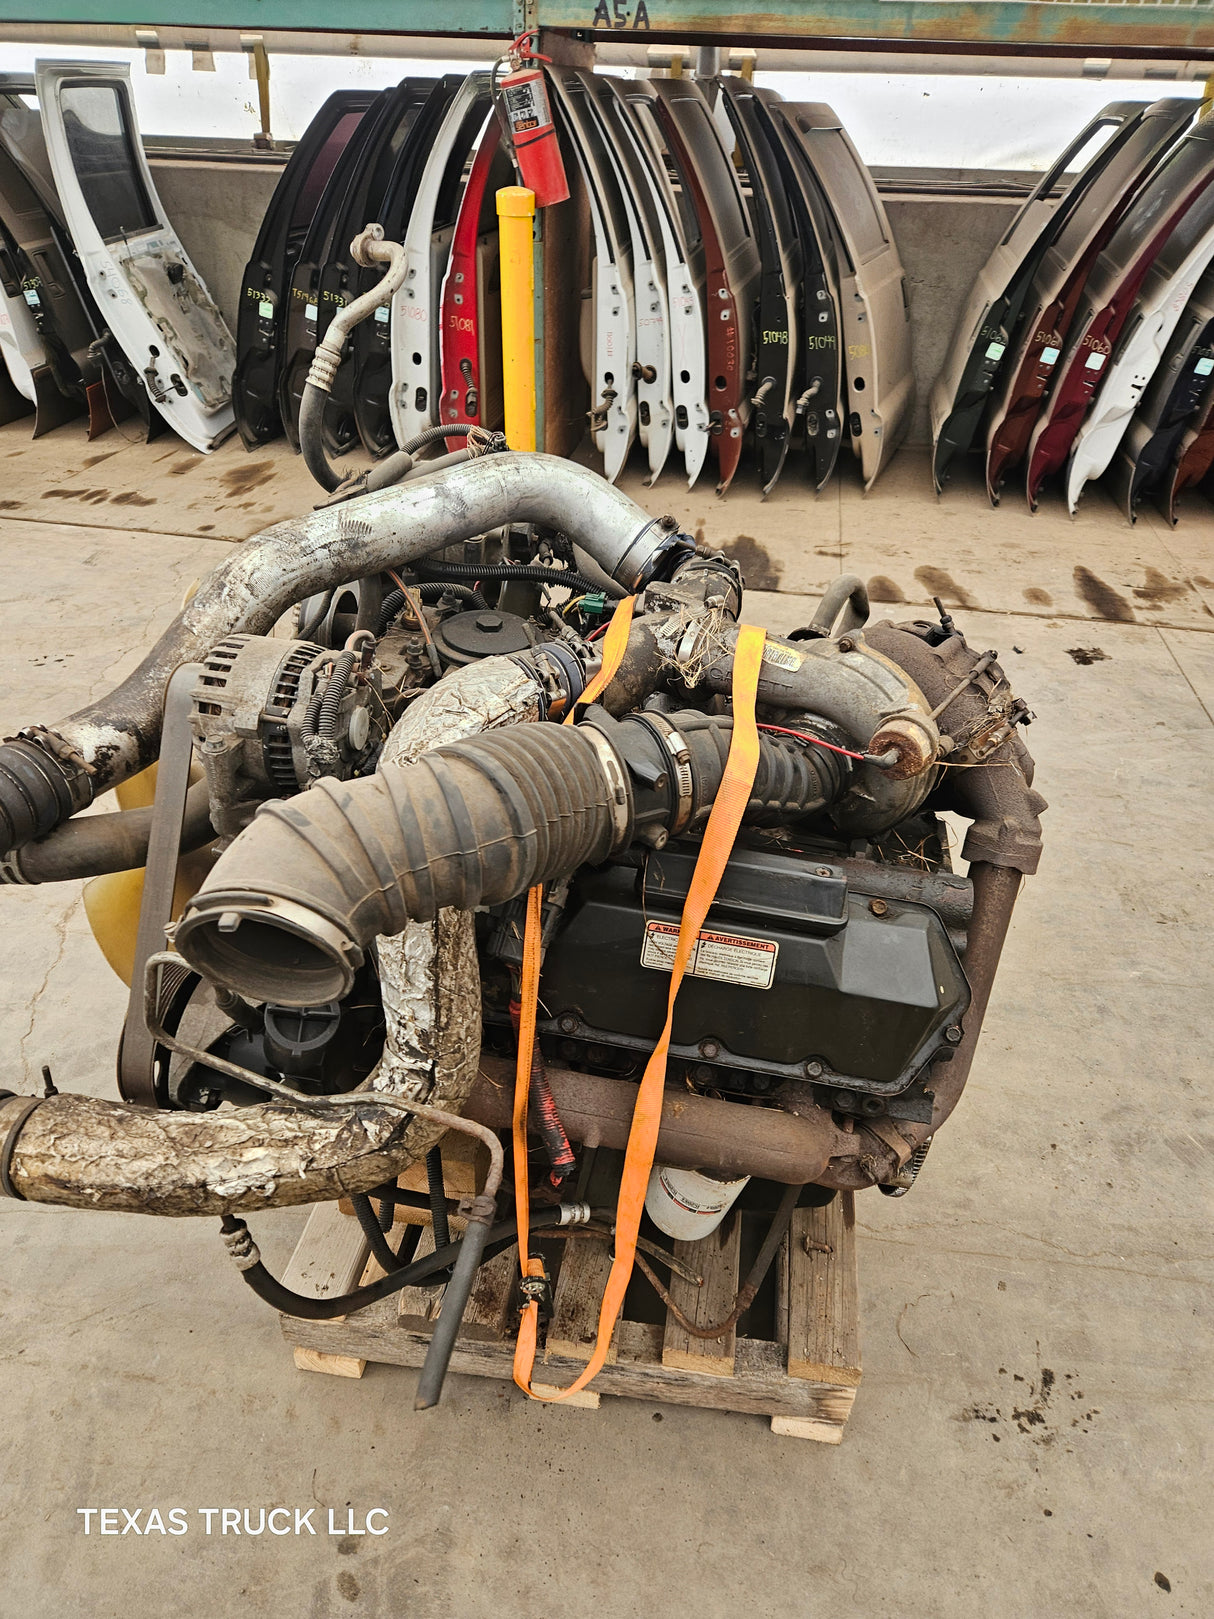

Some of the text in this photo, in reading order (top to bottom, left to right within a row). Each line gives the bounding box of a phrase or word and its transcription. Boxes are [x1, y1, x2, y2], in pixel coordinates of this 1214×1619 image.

[762, 330, 789, 345] 51048
[808, 335, 837, 350] 51049
[715, 936, 769, 950] AVERTISSEMENT
